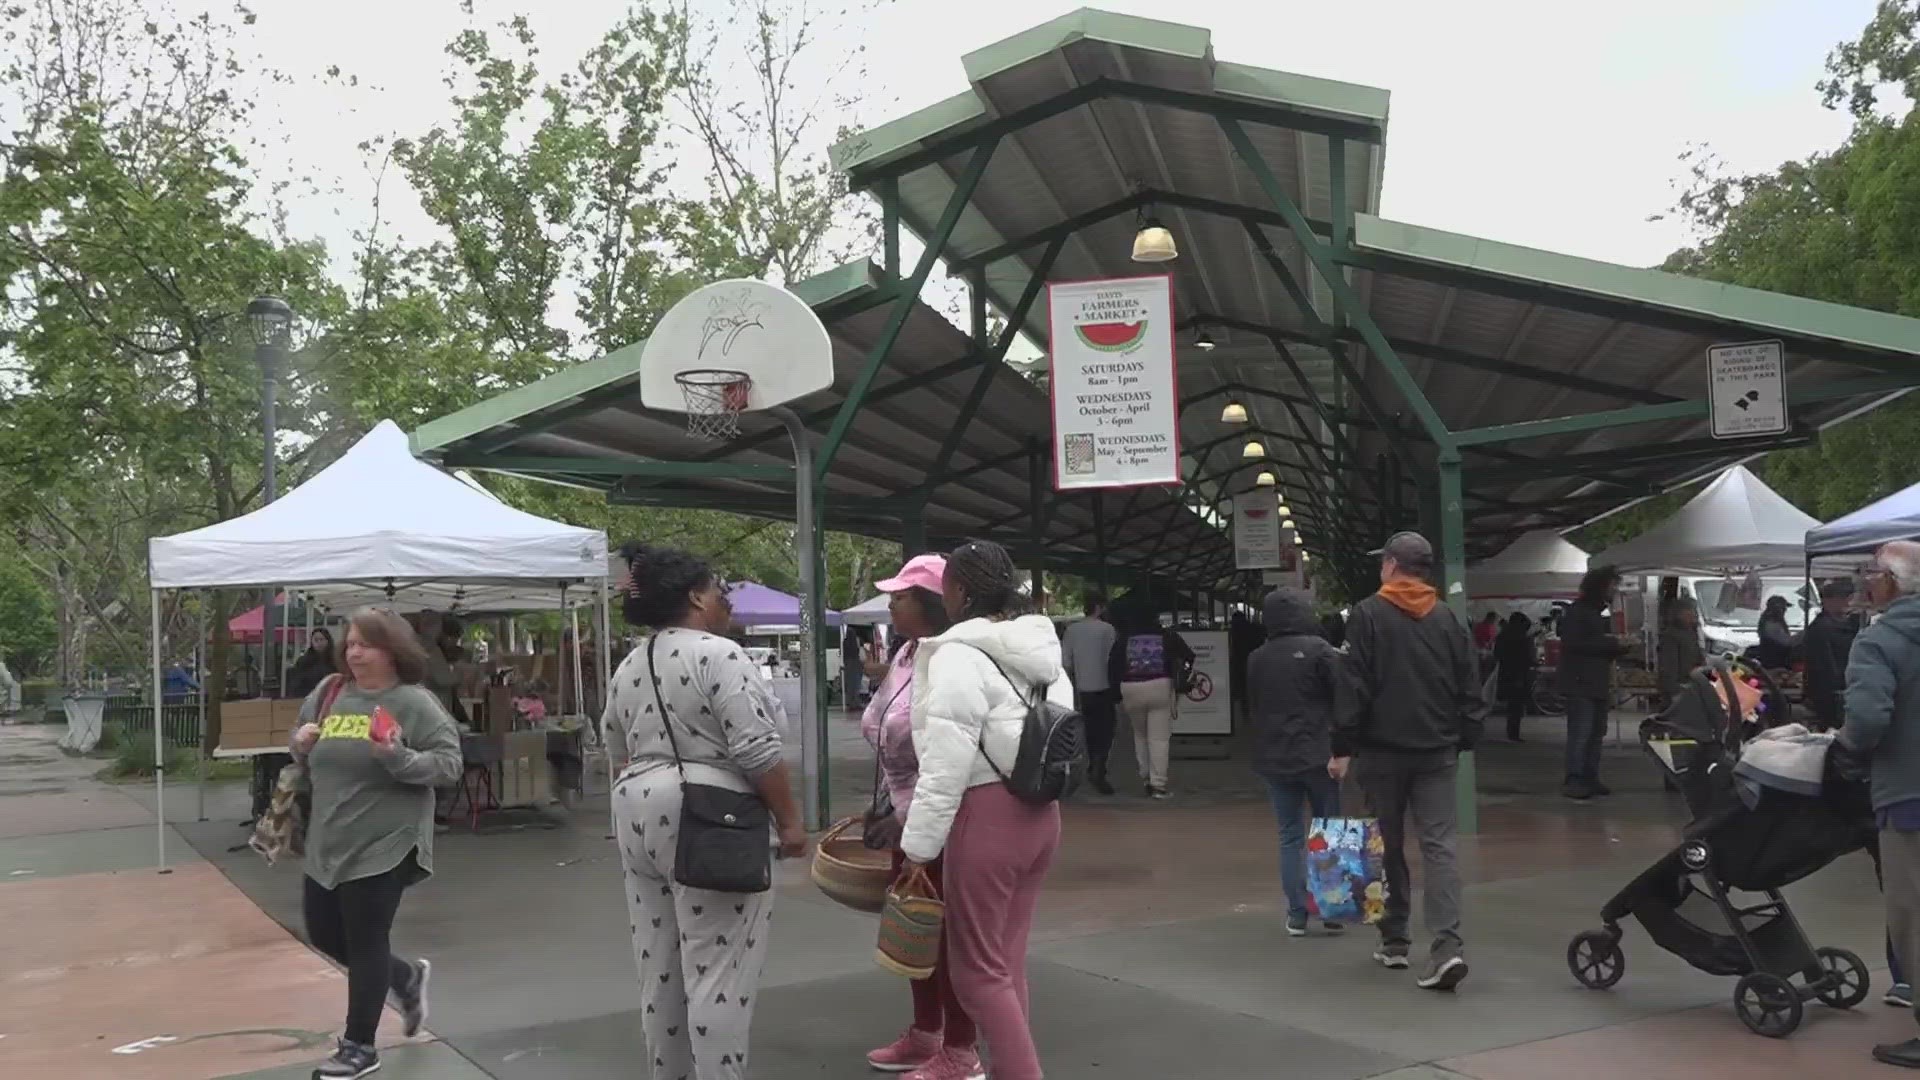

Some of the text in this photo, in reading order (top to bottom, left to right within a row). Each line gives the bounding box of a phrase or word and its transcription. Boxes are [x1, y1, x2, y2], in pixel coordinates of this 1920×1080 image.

[1082, 299, 1140, 311] FARMERS
[1084, 309, 1137, 321] MARKET
[1081, 361, 1145, 375] SATURDAYS
[1088, 377, 1109, 386] 8am
[1118, 375, 1139, 386] 1pm
[1076, 391, 1152, 405] WEDNESDAYS
[1079, 404, 1118, 416] October
[1126, 402, 1151, 415] April
[1097, 417, 1104, 426] 3
[1111, 417, 1134, 427] 6pm
[1097, 434, 1167, 446] WEDNESDAYS
[1097, 447, 1116, 457] May
[1123, 444, 1168, 456] September
[1129, 457, 1149, 466] 8pm
